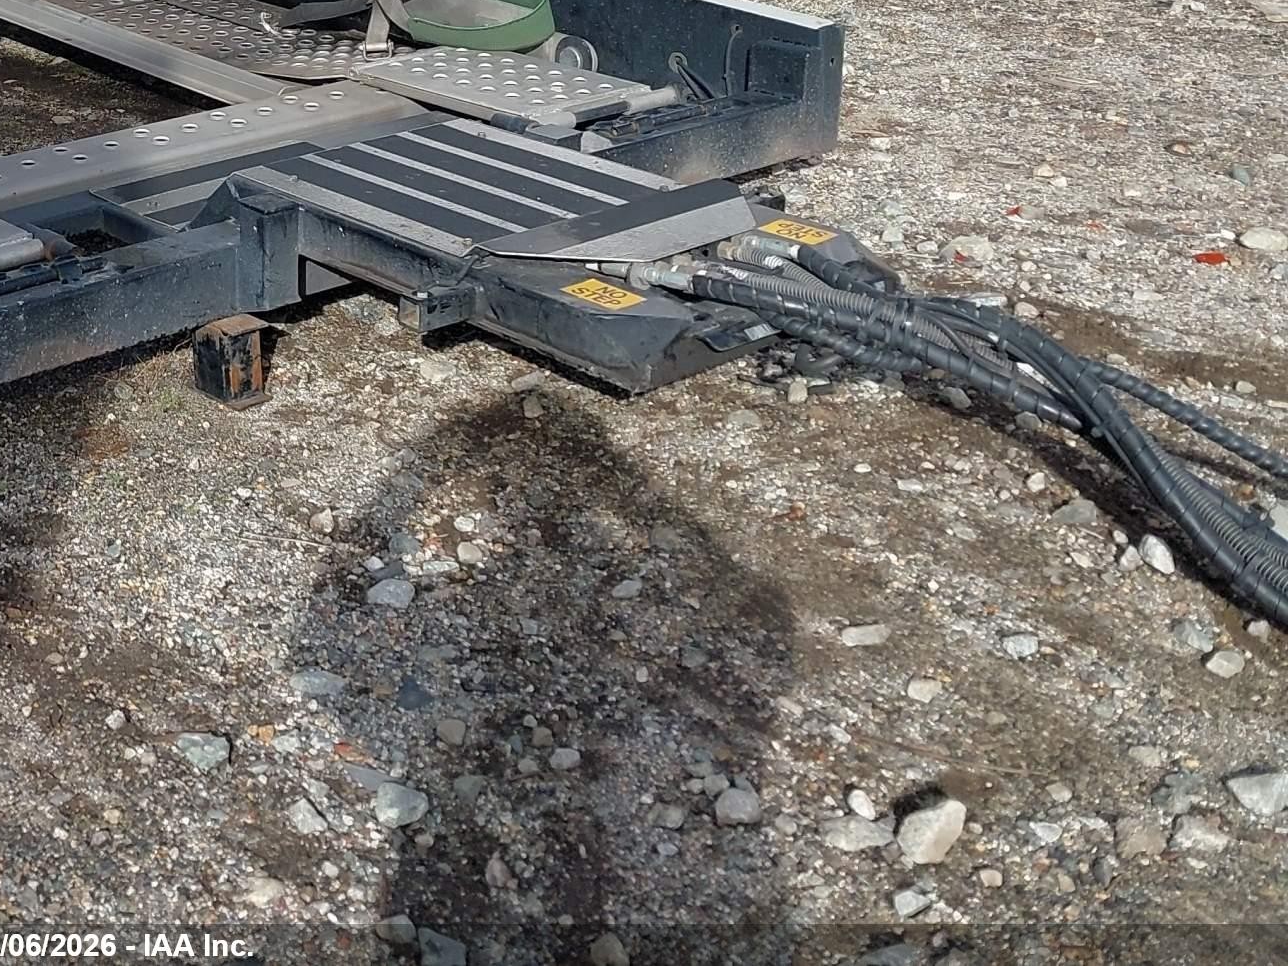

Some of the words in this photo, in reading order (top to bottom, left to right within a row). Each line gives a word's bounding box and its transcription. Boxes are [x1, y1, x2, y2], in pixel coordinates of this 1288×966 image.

[776, 229, 807, 240] NO
[778, 223, 828, 238] STEP
[571, 287, 622, 306] STEP
[594, 286, 628, 299] NO
